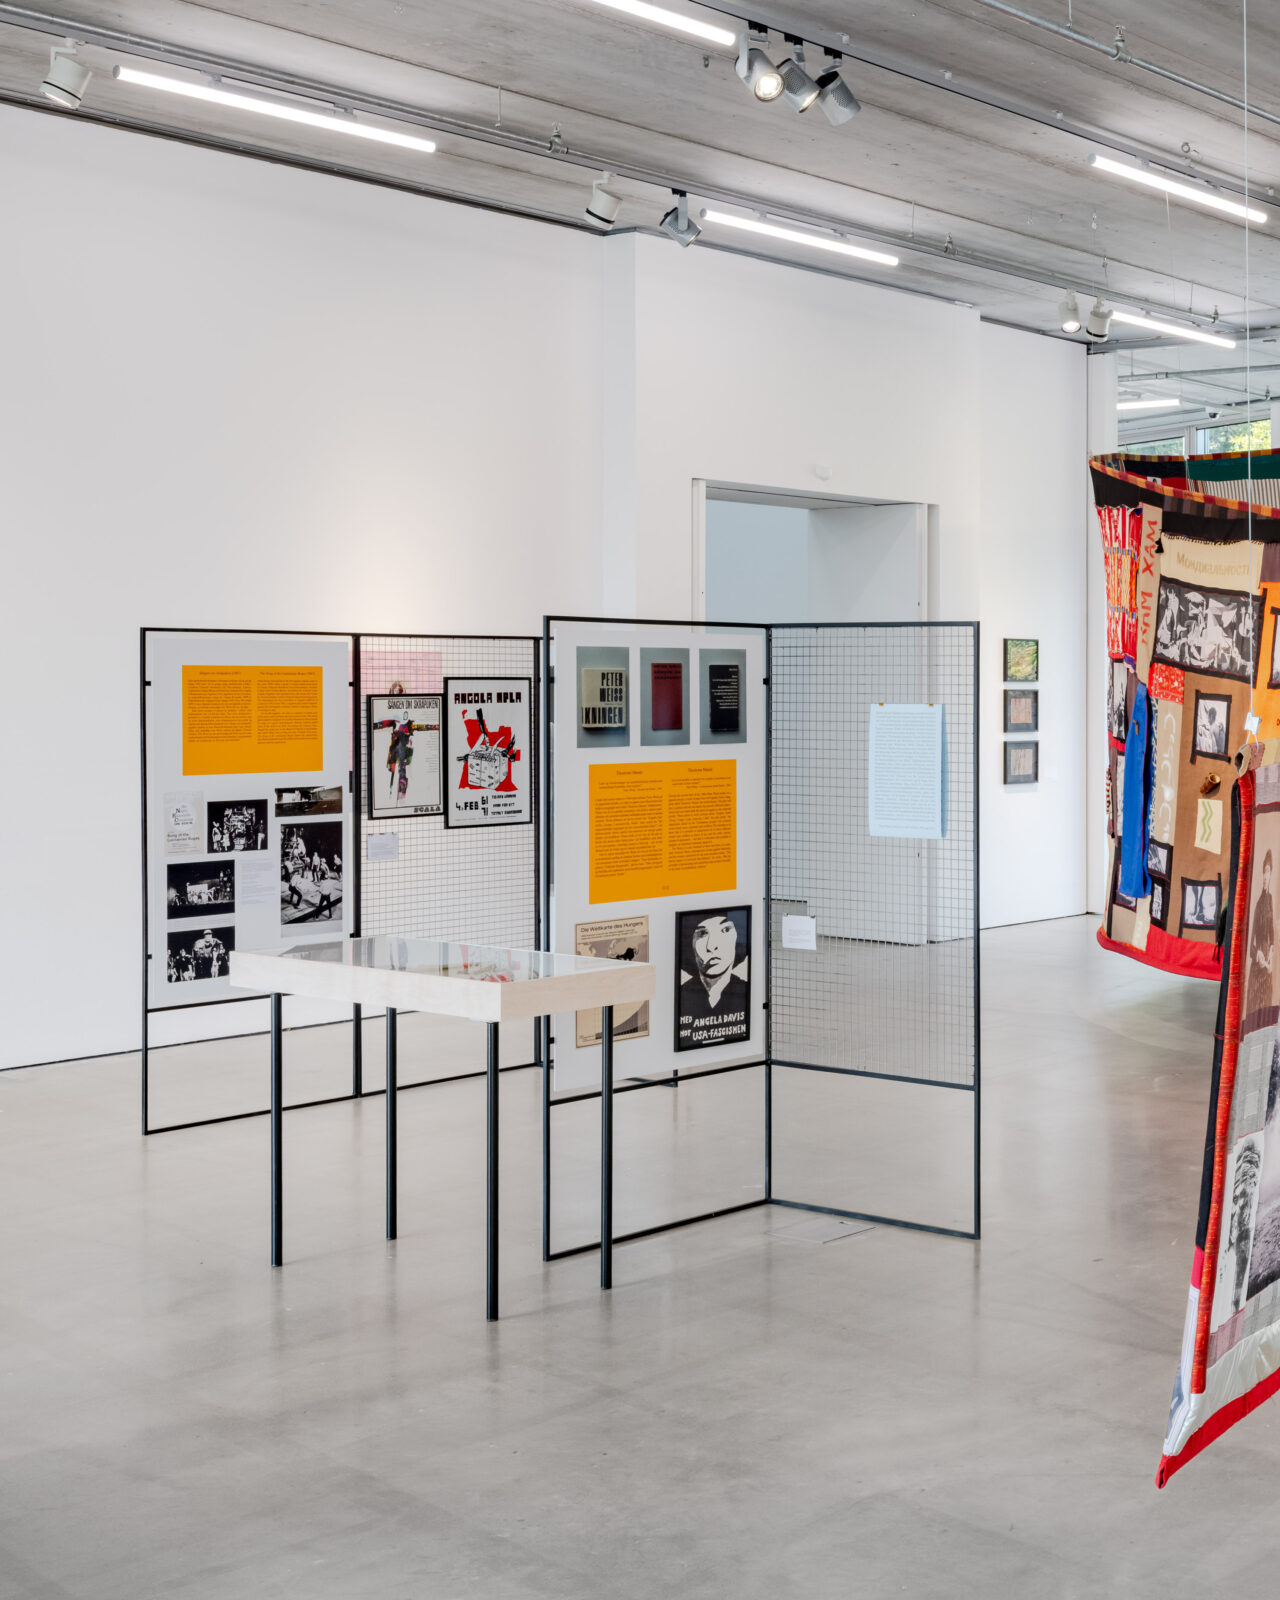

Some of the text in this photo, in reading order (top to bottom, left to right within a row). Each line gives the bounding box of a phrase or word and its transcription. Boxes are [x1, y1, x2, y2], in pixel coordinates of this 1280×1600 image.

[601, 672, 623, 687] PETER
[454, 692, 493, 705] ANGOLA
[600, 688, 623, 702] WEISS
[680, 1011, 745, 1028] MED ANGELA DAVIS
[692, 1023, 747, 1041] USA-FASCISMEN
